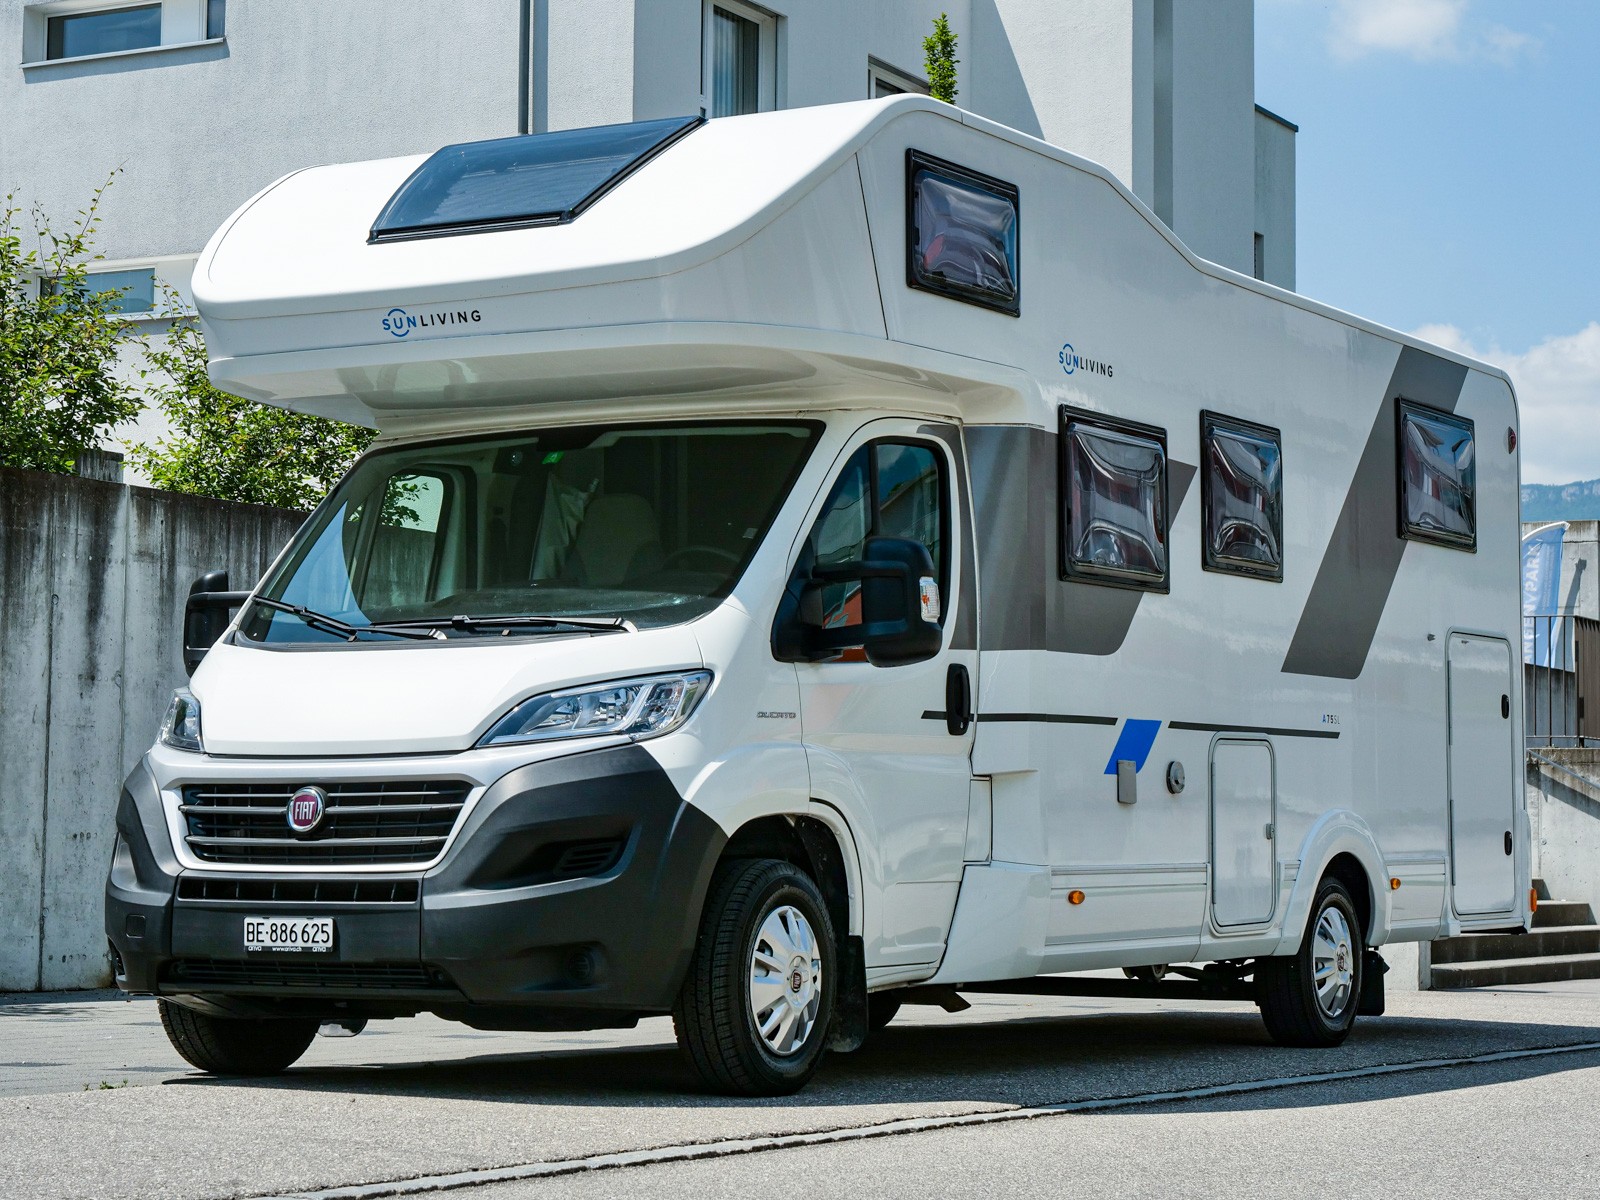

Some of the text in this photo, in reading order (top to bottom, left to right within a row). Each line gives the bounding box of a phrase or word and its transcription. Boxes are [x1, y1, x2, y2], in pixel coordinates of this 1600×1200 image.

[382, 309, 482, 331] SUNLIVING
[1058, 350, 1113, 378] SUNLIVING
[295, 801, 315, 820] FIAT
